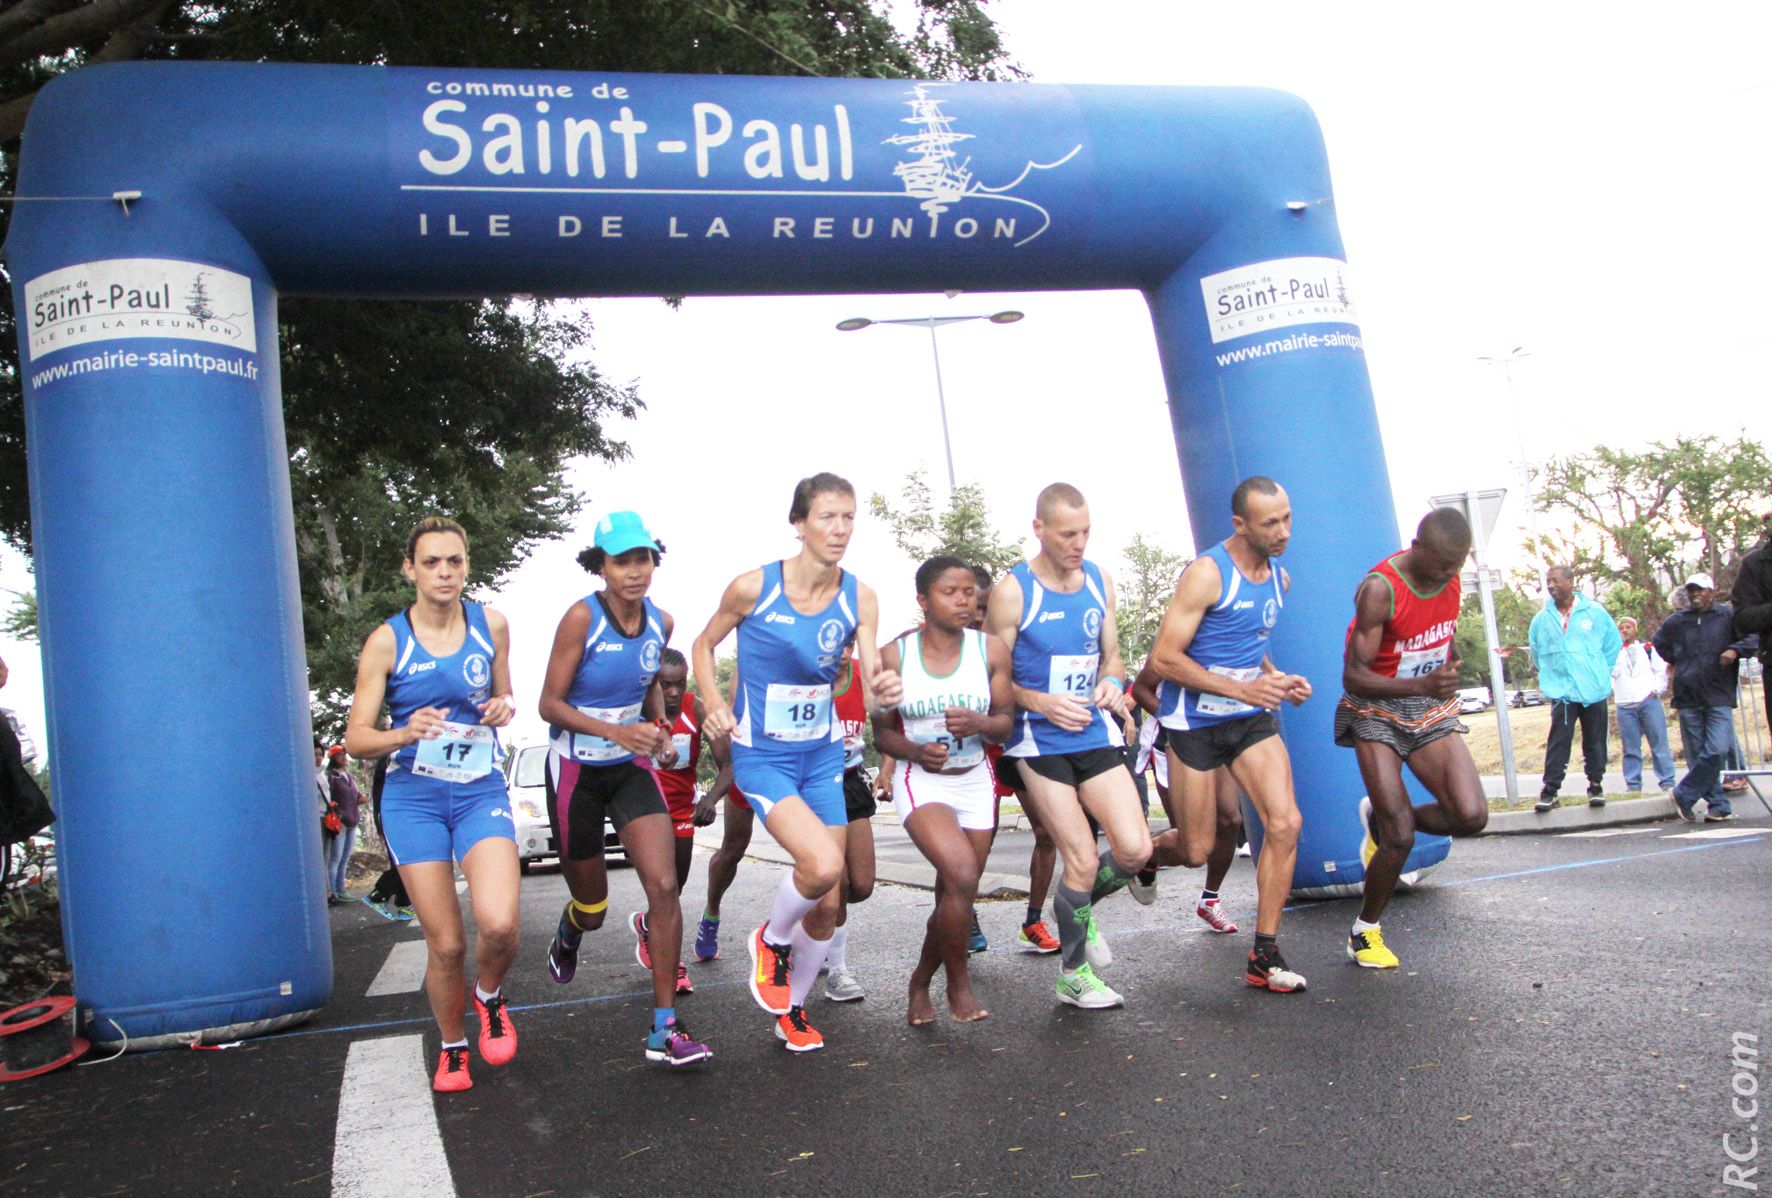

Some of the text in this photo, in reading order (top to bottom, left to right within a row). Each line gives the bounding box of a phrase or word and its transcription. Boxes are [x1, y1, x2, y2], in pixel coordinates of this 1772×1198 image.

[427, 80, 629, 100] commune de
[418, 99, 854, 182] Saint-Paul
[418, 212, 512, 237] ILE
[557, 214, 624, 239] DE
[668, 215, 732, 239] LA
[35, 280, 89, 300] commune de
[1217, 275, 1272, 294] commune de
[1218, 277, 1330, 316] Saint-Paul
[34, 283, 170, 328] Saint-Paul
[35, 332, 56, 347] ILE
[67, 324, 88, 335] DE
[102, 319, 125, 329] LA
[1220, 319, 1245, 332] ILE
[1257, 313, 1275, 323] DE
[1287, 309, 1305, 317] LA
[32, 349, 258, 389] www.mairie-saintpaul.fr
[787, 703, 816, 722] 18
[442, 742, 472, 762] 17
